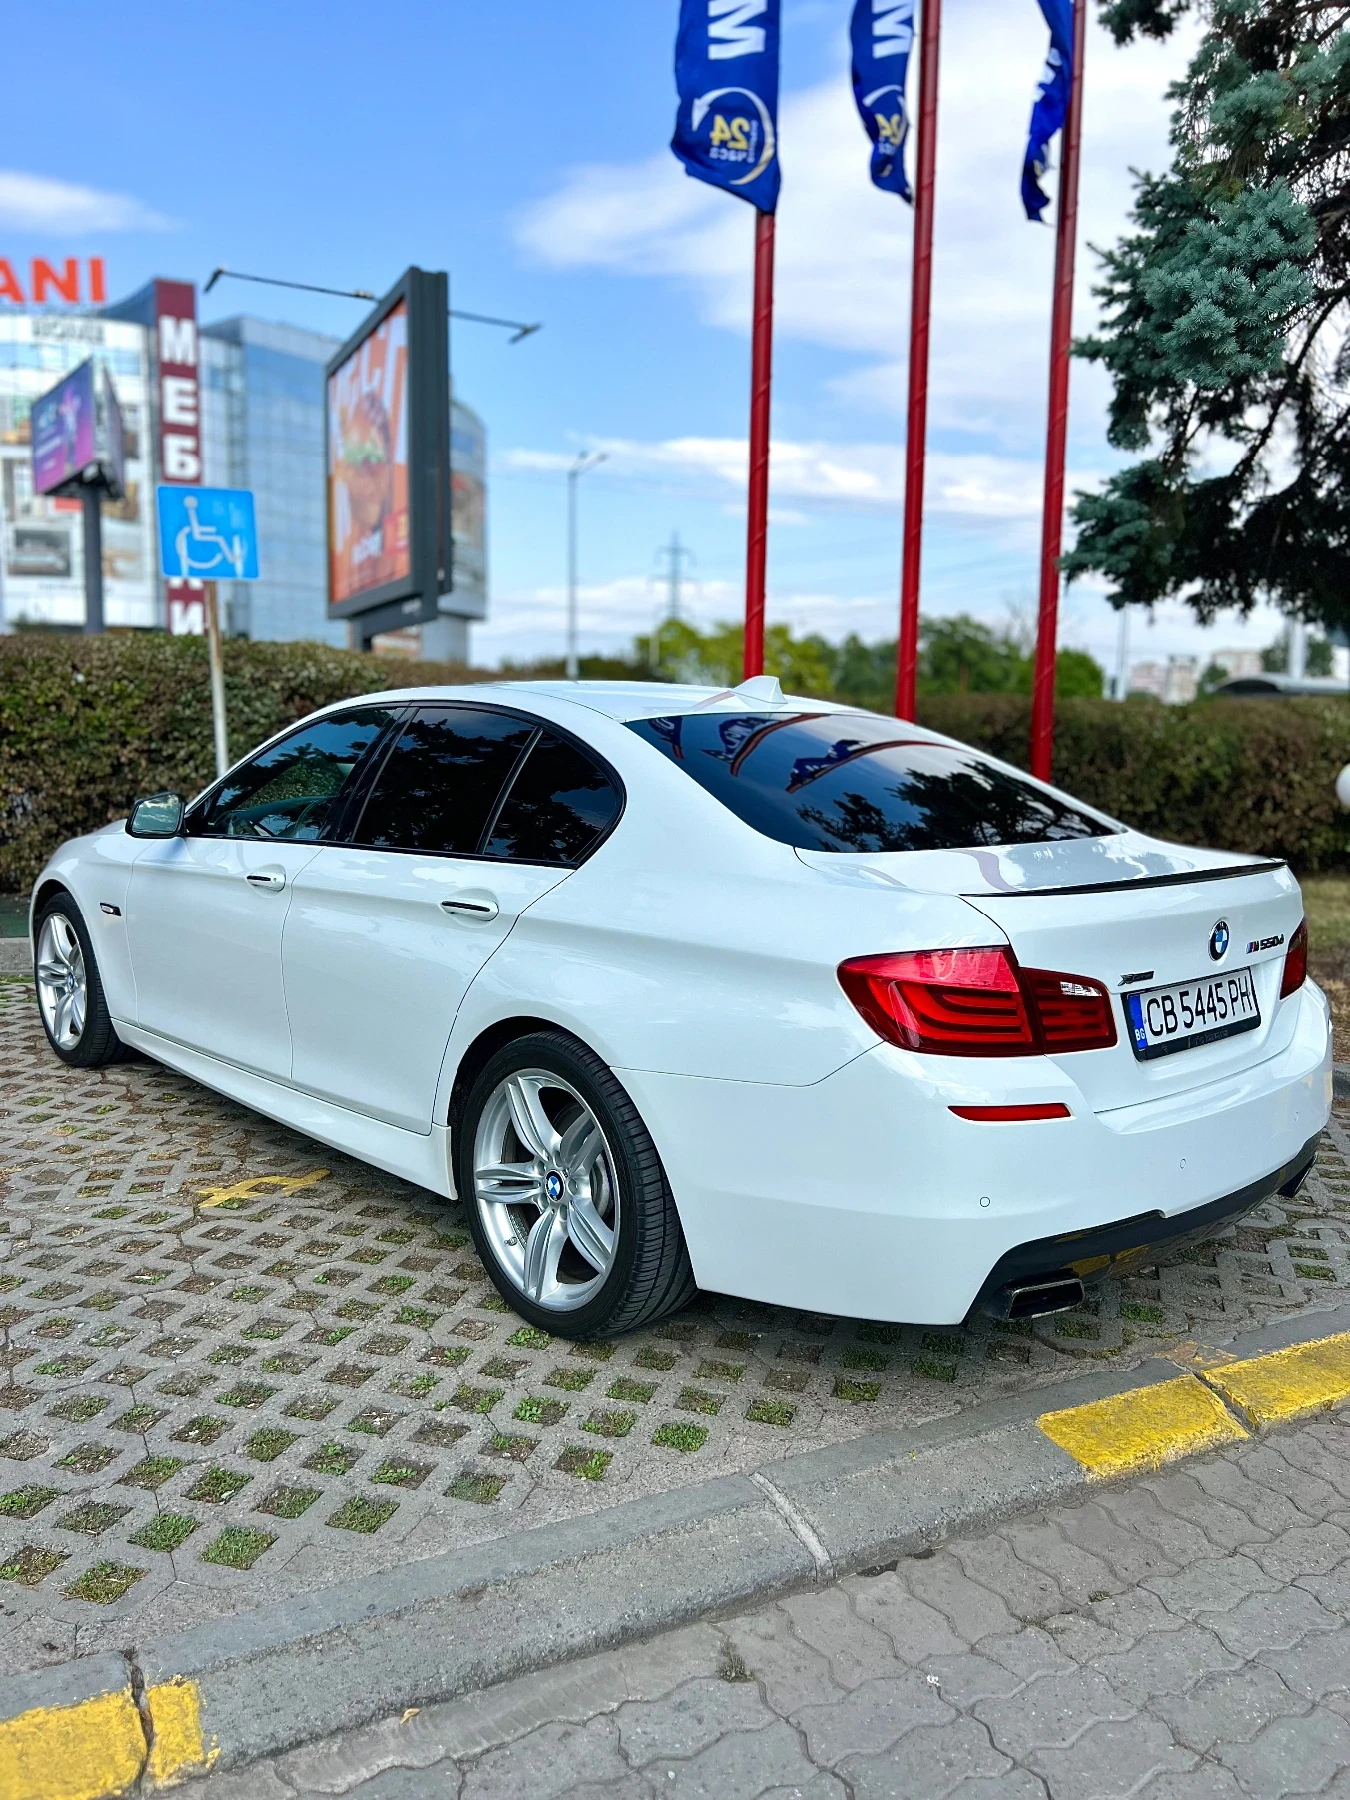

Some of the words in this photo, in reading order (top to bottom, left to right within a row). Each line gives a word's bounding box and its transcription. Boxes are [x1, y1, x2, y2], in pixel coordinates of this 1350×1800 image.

[1147, 995, 1179, 1036] CB
[1179, 982, 1228, 1029] 5445
[1228, 976, 1253, 1016] PH
[1135, 1028, 1146, 1040] BG
